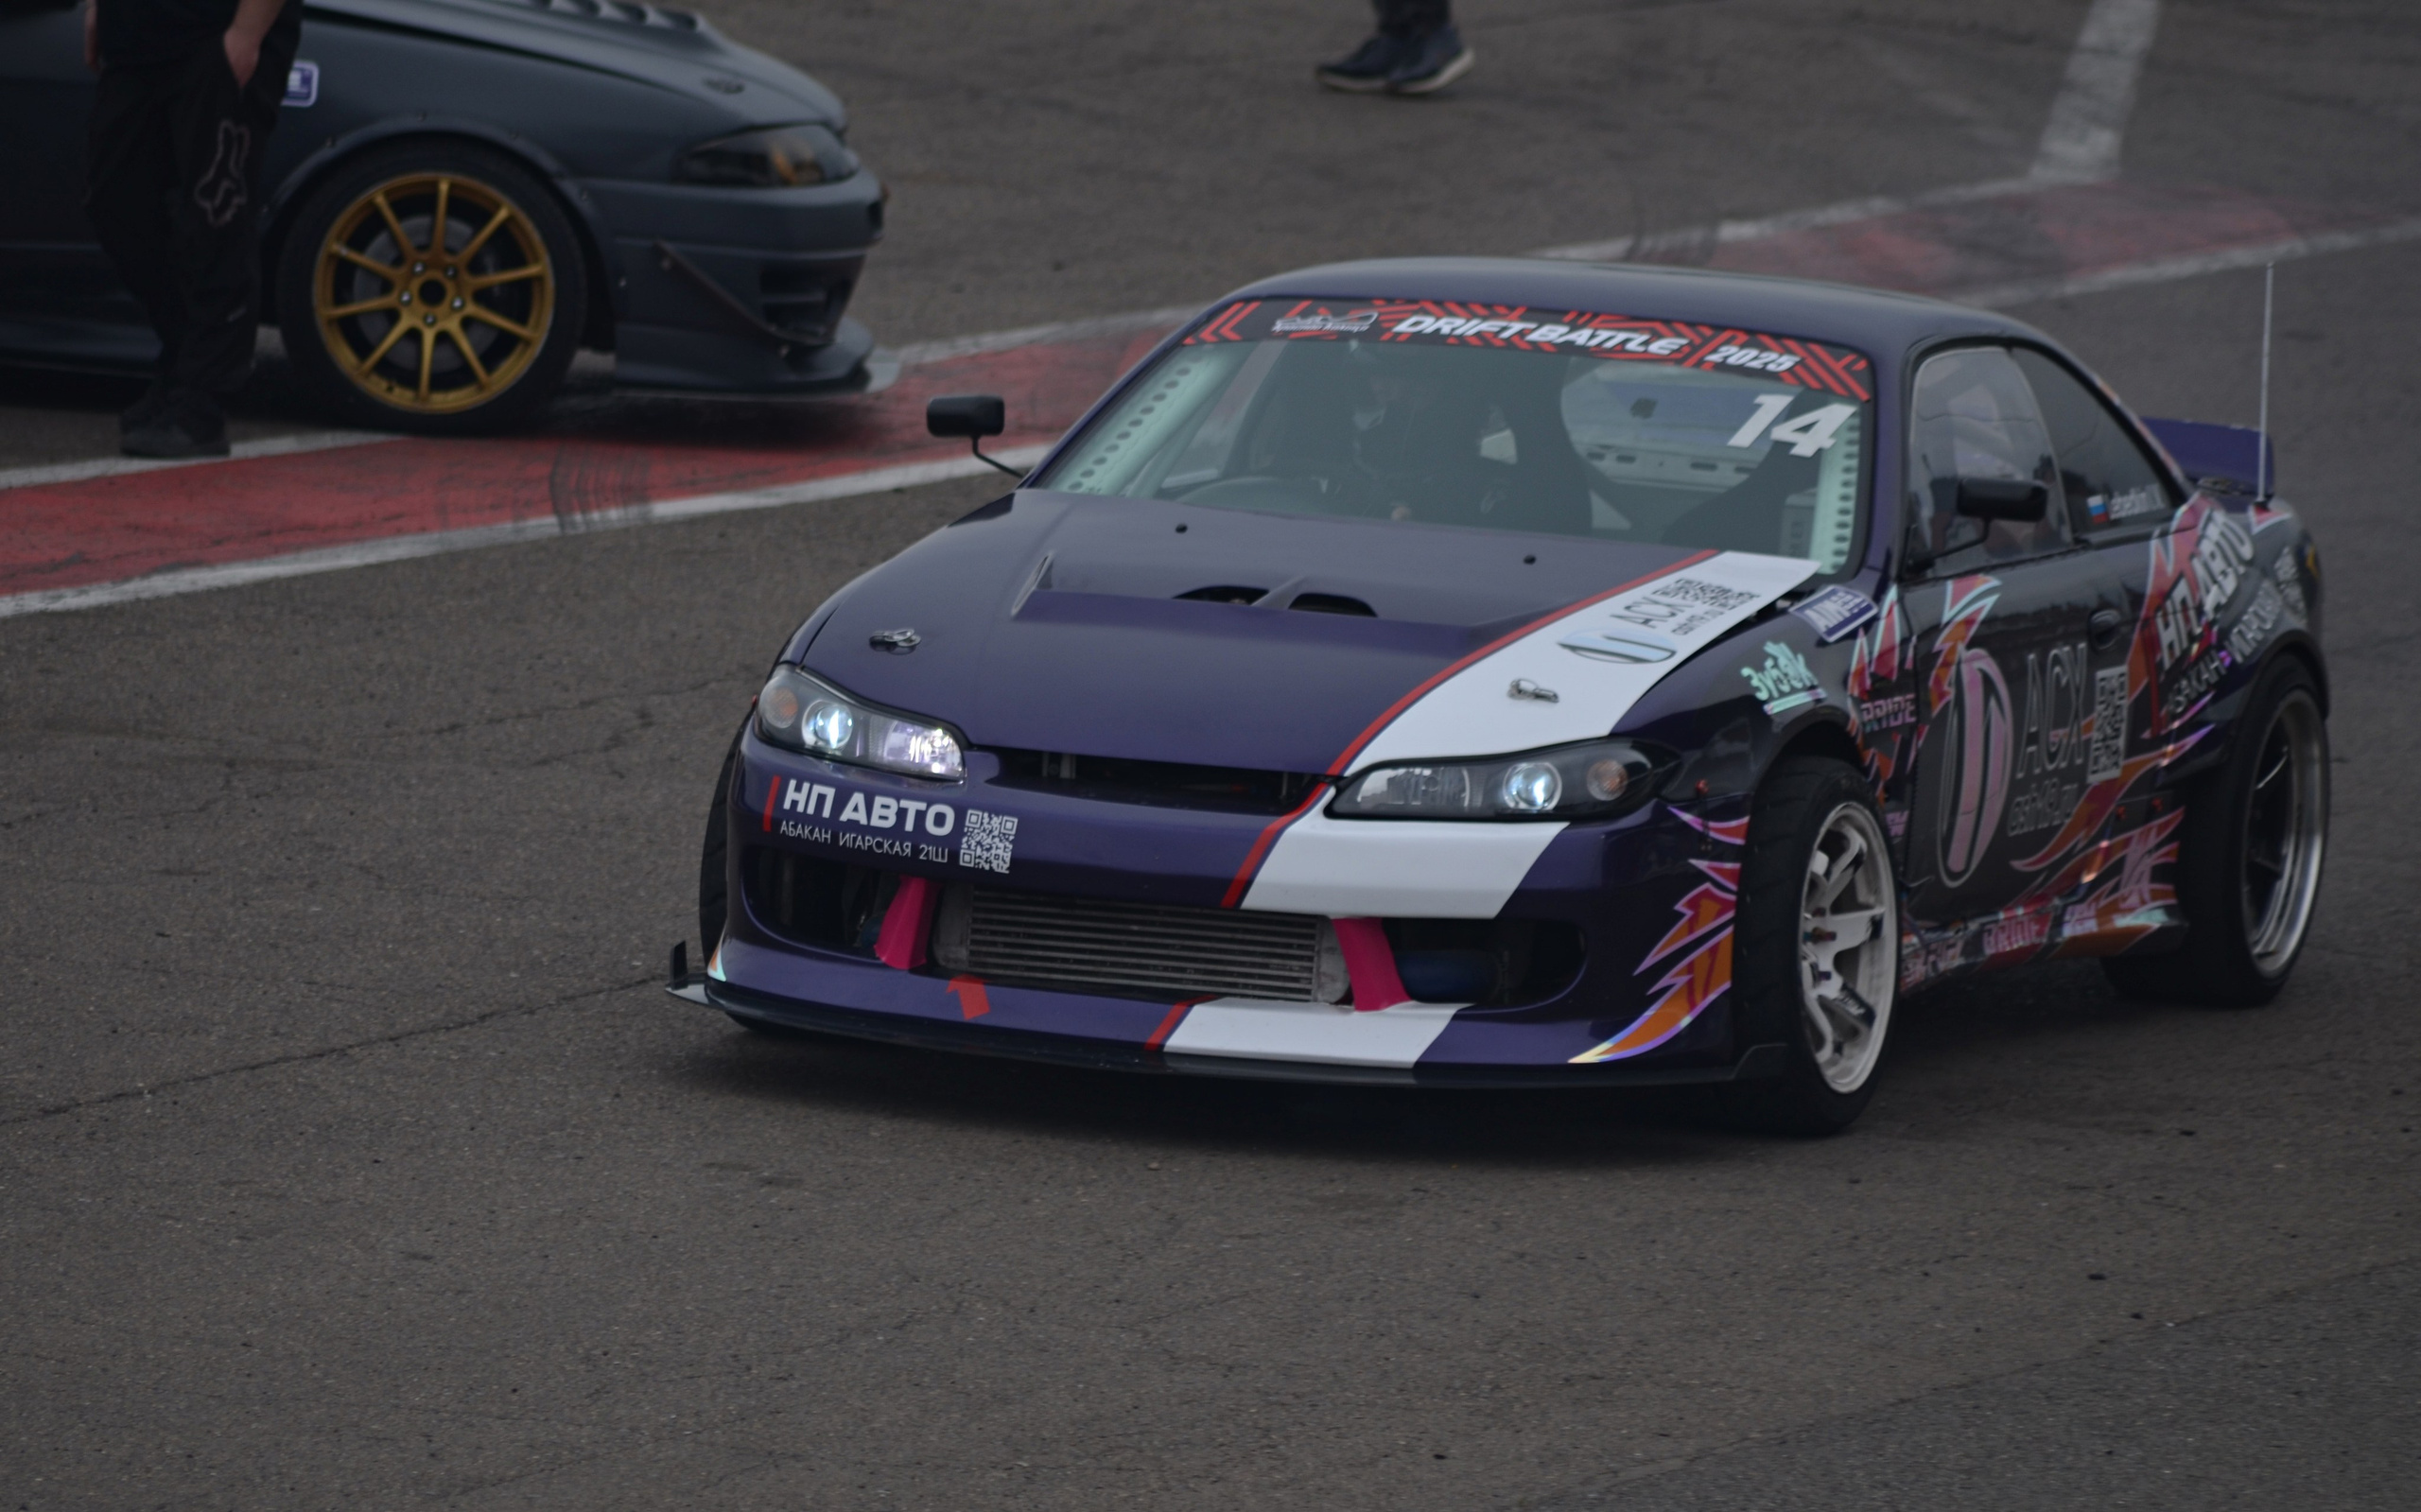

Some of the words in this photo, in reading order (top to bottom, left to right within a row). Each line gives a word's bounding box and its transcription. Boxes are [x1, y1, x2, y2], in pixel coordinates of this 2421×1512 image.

[1392, 314, 1540, 339] DRIFT
[1524, 323, 1691, 356] BATTLE
[1703, 344, 1802, 373] 2025
[1726, 392, 1855, 459] 14
[783, 778, 836, 819] НП
[839, 791, 955, 836] АВТО
[780, 820, 832, 844] АБАКАН
[839, 831, 912, 858] ИГАРСКАЯ
[919, 844, 949, 862] 21Ш
